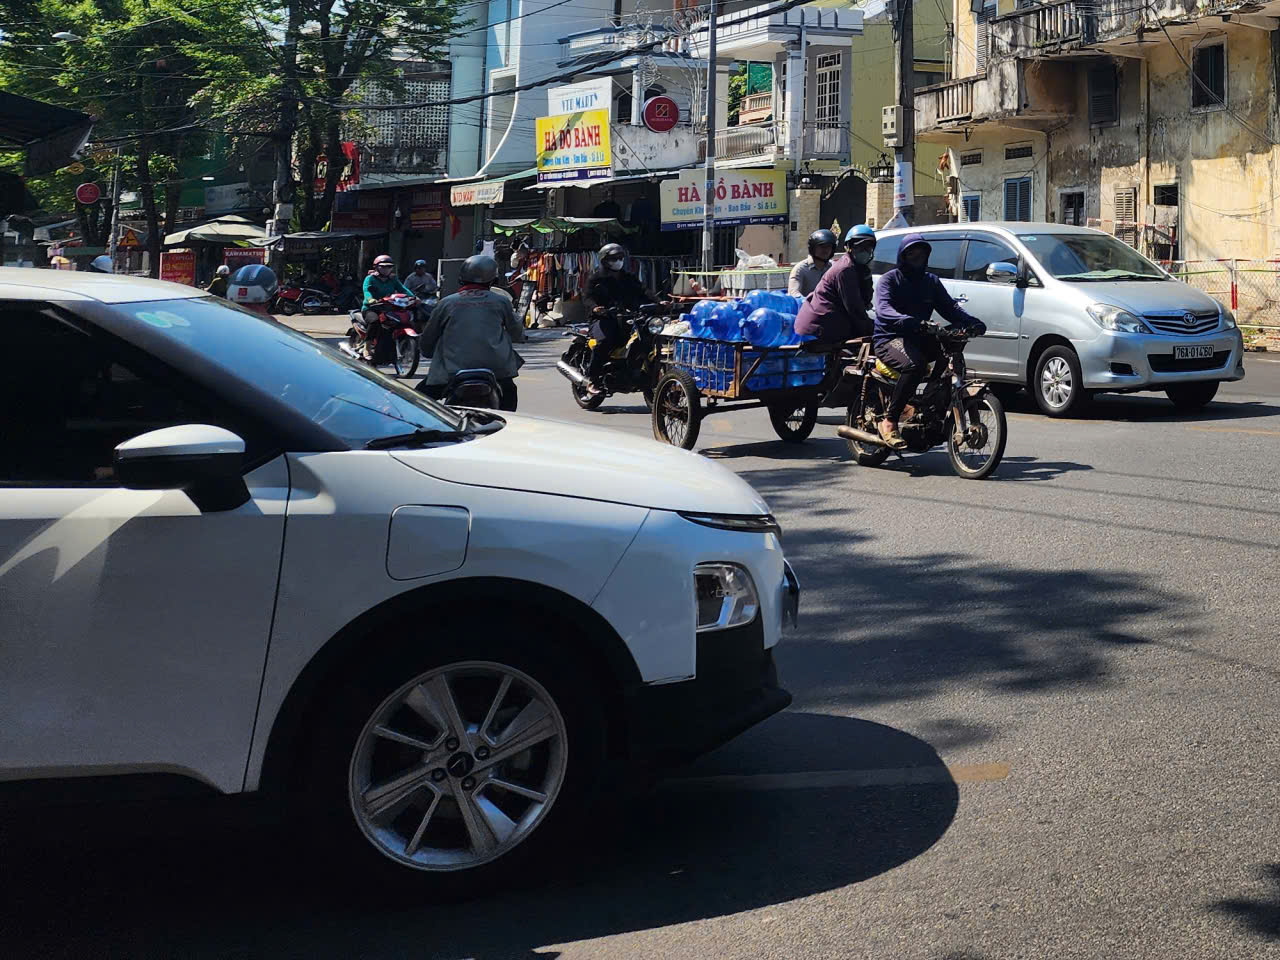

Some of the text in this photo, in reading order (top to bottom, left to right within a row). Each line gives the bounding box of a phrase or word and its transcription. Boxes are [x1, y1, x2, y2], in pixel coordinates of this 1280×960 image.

[544, 123, 557, 151] HÀ
[574, 120, 600, 148] BÀNH
[677, 182, 700, 203] HÀ
[731, 180, 774, 200] BÀNH
